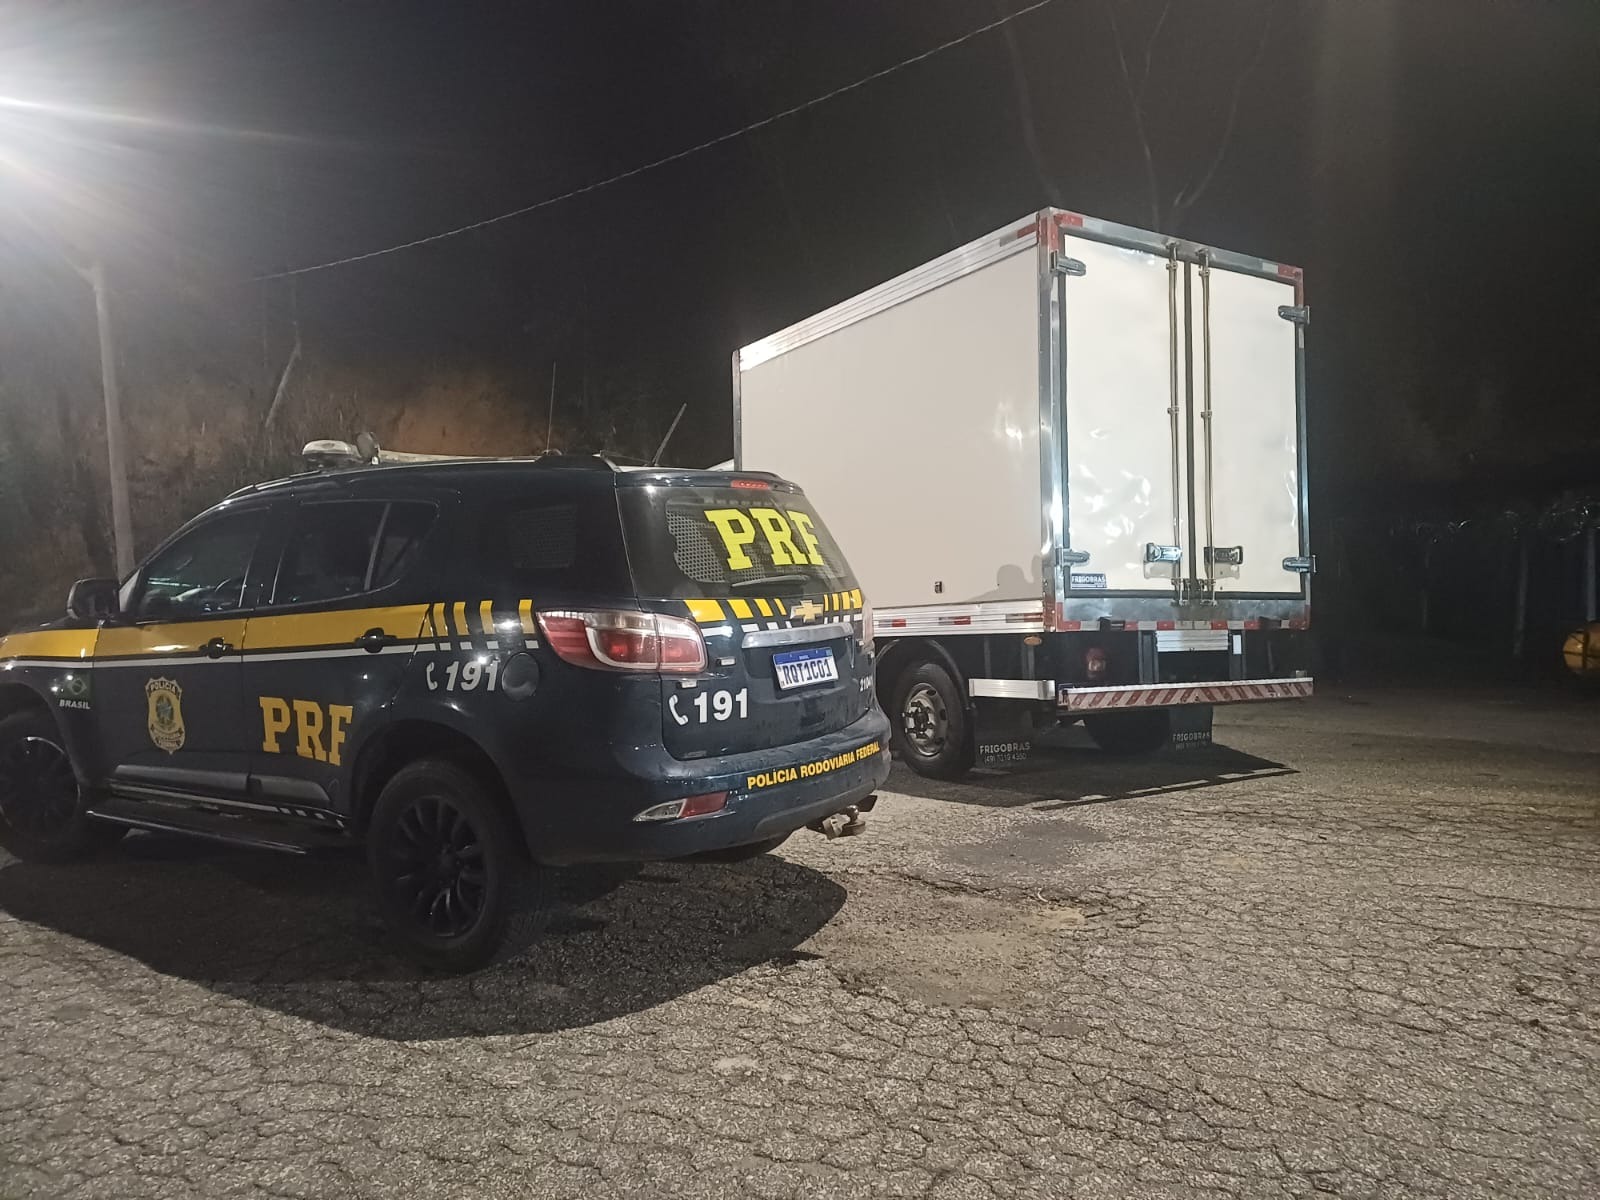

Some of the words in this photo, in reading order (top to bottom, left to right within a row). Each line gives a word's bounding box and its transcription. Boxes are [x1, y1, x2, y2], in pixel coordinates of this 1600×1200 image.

[704, 508, 824, 571] PRF
[446, 660, 501, 691] 191
[59, 699, 91, 710] BRASIL
[694, 689, 748, 723] 191
[259, 696, 354, 766] PRF
[979, 741, 1031, 755] FRIGOBRAS
[747, 769, 798, 790] POLÍCIA
[800, 752, 855, 778] RODOVIÁRIA
[856, 742, 880, 761] FEDERAL
